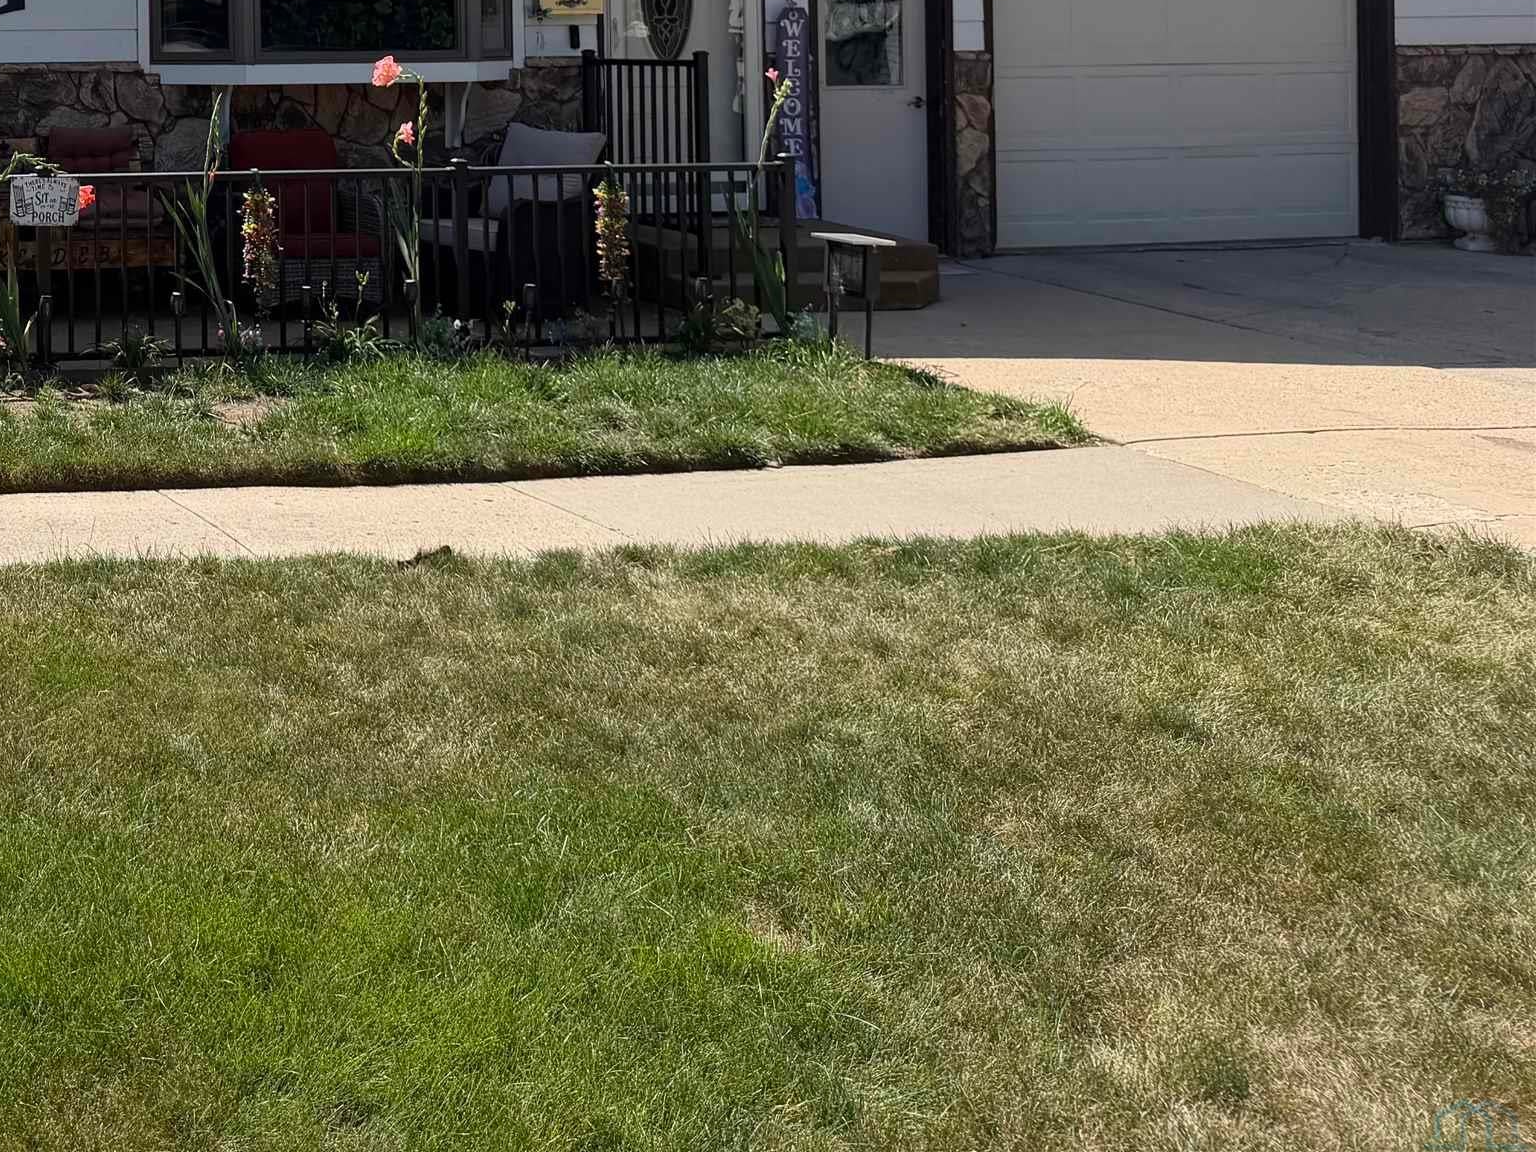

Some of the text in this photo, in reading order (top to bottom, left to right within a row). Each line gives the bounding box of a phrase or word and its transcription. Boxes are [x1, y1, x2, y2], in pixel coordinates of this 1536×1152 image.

[779, 19, 804, 156] WELCOME
[35, 191, 49, 206] SIT
[31, 211, 65, 223] PORCH
